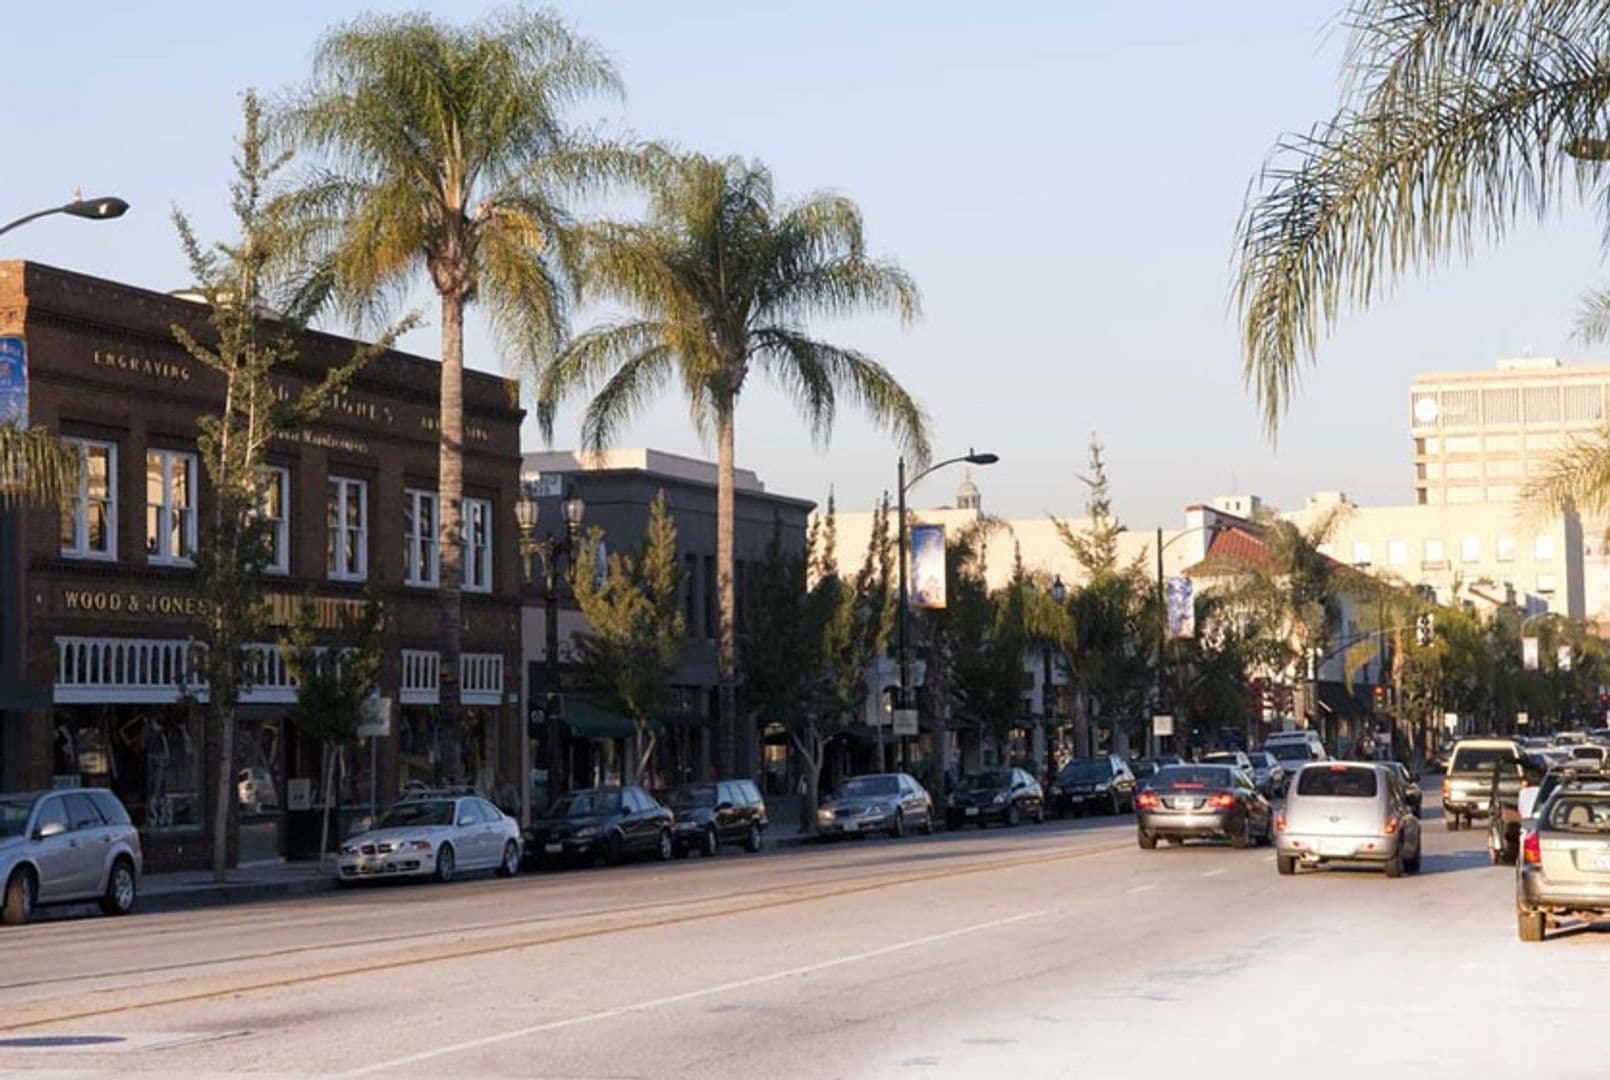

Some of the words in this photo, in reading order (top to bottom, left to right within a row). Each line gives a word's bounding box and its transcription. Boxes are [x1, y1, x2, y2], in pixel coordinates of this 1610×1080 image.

[94, 350, 191, 381] ENGRAVING
[65, 591, 121, 611] WOOD
[127, 594, 140, 612] &
[146, 596, 208, 614] JONES
